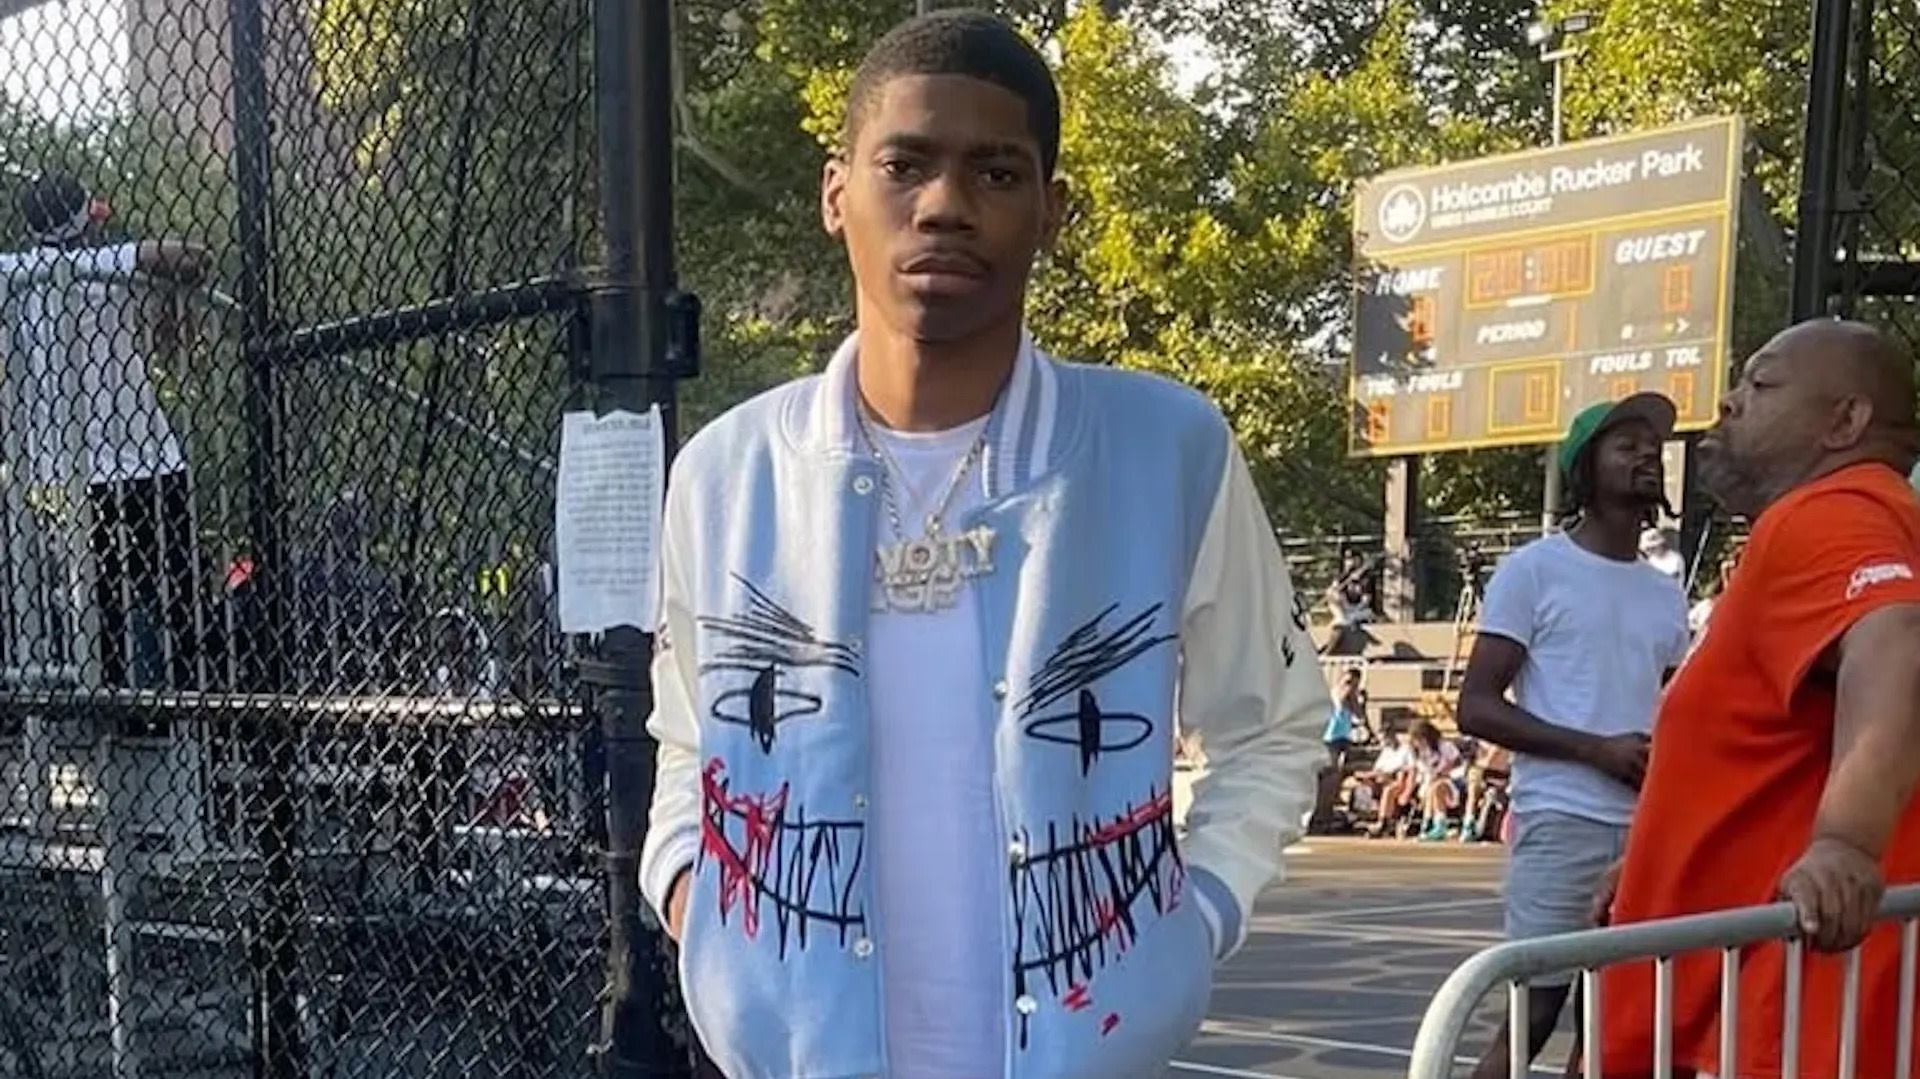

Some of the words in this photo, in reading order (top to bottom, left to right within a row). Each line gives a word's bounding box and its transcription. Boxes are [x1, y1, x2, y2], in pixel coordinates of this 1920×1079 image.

[1431, 170, 1546, 211] Holcombe
[1551, 159, 1637, 195] Rucker
[1640, 144, 1703, 179] Park
[1615, 230, 1706, 264] GUEST
[1376, 267, 1446, 297] HOME
[1476, 320, 1547, 345] PERIOD
[1590, 350, 1653, 374] FOULS
[1407, 370, 1464, 393] FOULS
